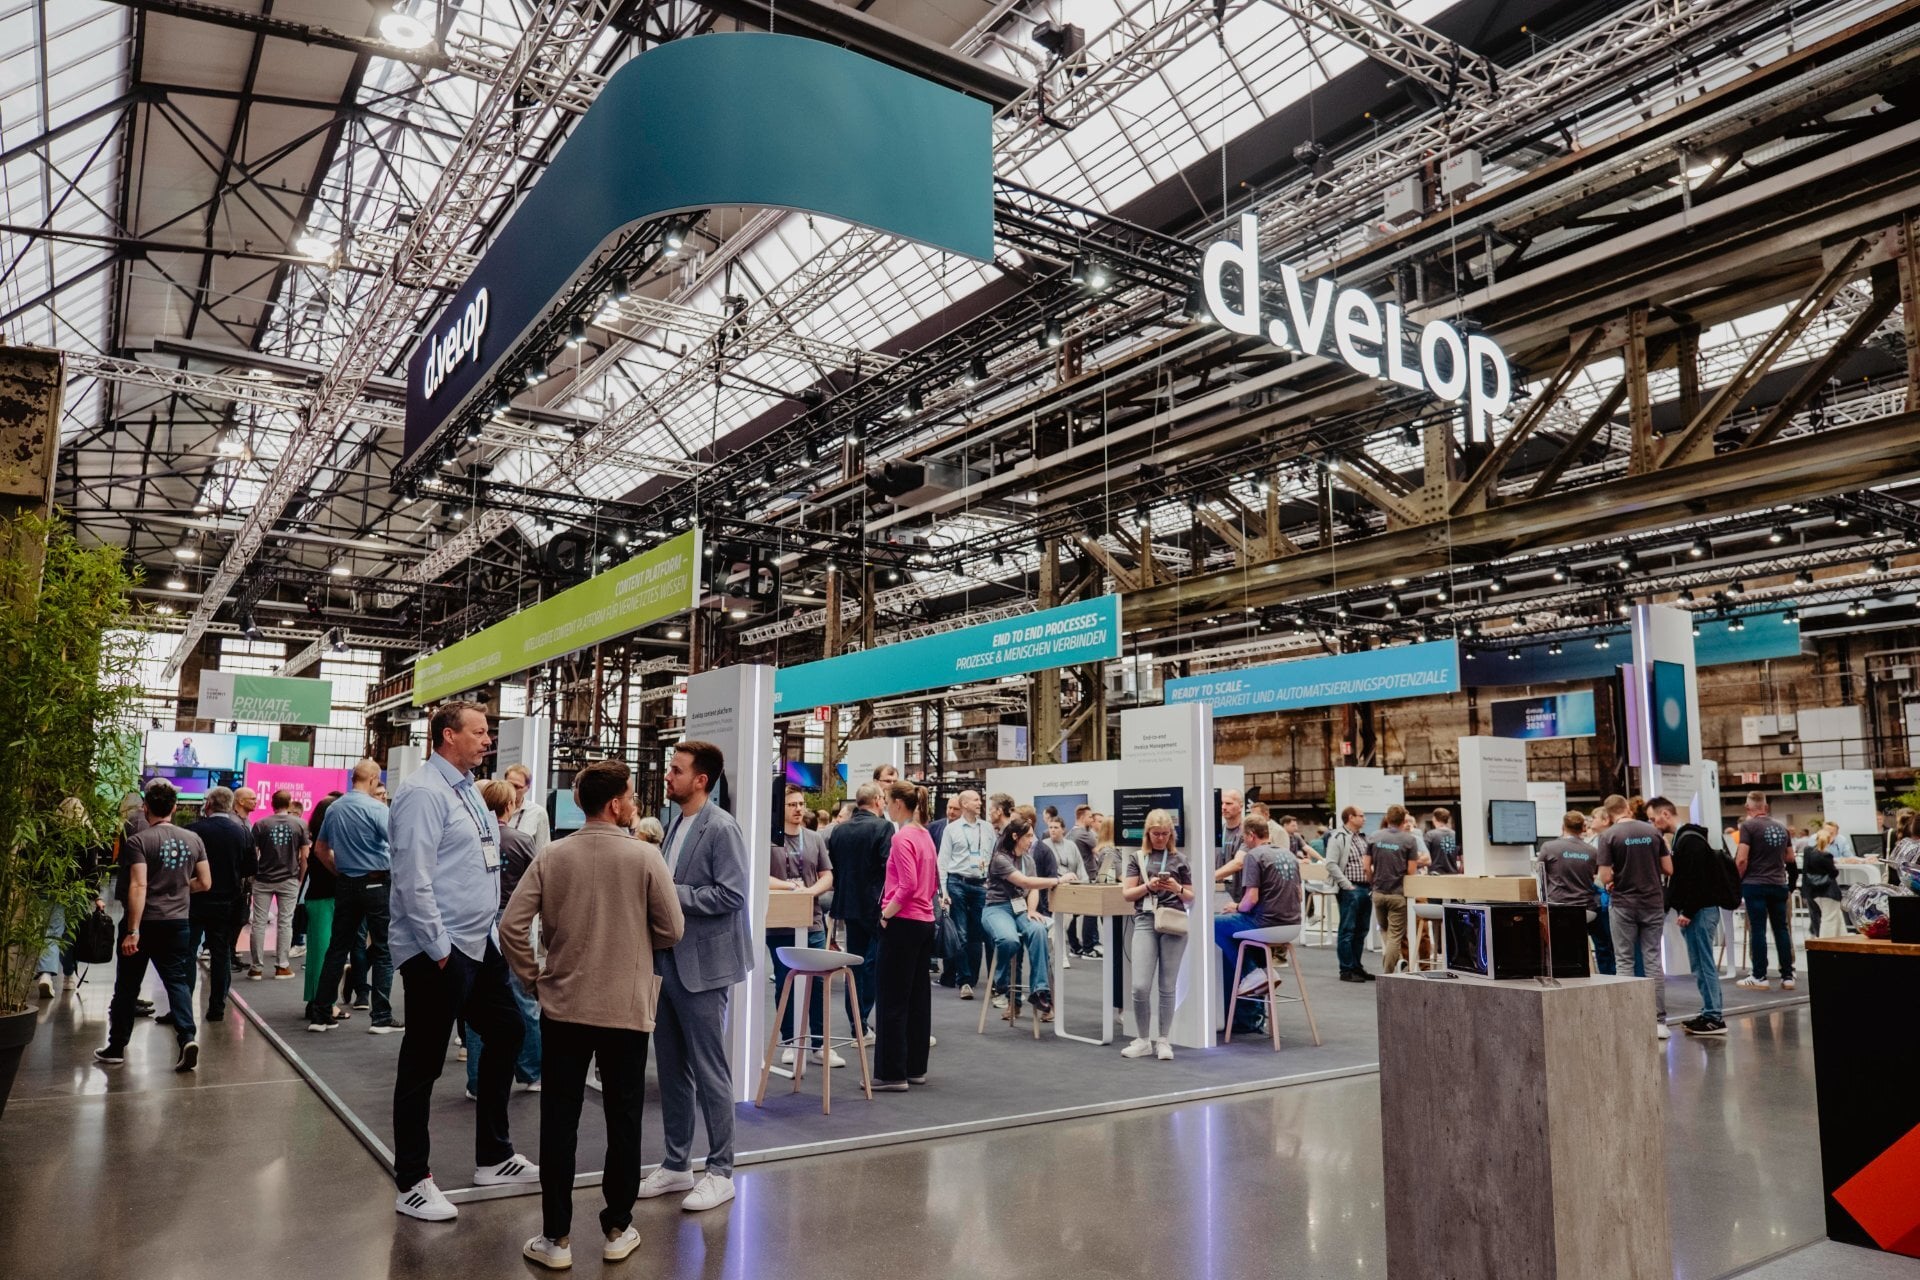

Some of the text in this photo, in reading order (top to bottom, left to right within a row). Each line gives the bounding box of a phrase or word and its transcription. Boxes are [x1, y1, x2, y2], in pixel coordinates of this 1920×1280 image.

[615, 570, 646, 597] CONTENT
[644, 553, 682, 584] PLATFORM
[576, 607, 607, 632] PLATFORM
[619, 585, 660, 616] VERNETZTES
[660, 572, 688, 600] WISSEN
[992, 632, 1011, 648] END
[1012, 629, 1023, 644] TO
[1024, 625, 1044, 641] END
[1044, 612, 1098, 637] PROCESSES
[955, 629, 1107, 671] PROZESSE & MENSCHEN VERBINDEN
[1171, 687, 1201, 701] READY
[1201, 685, 1213, 696] TO
[1215, 680, 1243, 694] SCALE
[1252, 689, 1275, 704] UND
[233, 696, 292, 712] PRIVATE
[232, 708, 301, 722] ECONOMY
[1525, 713, 1557, 722] SUMMIT
